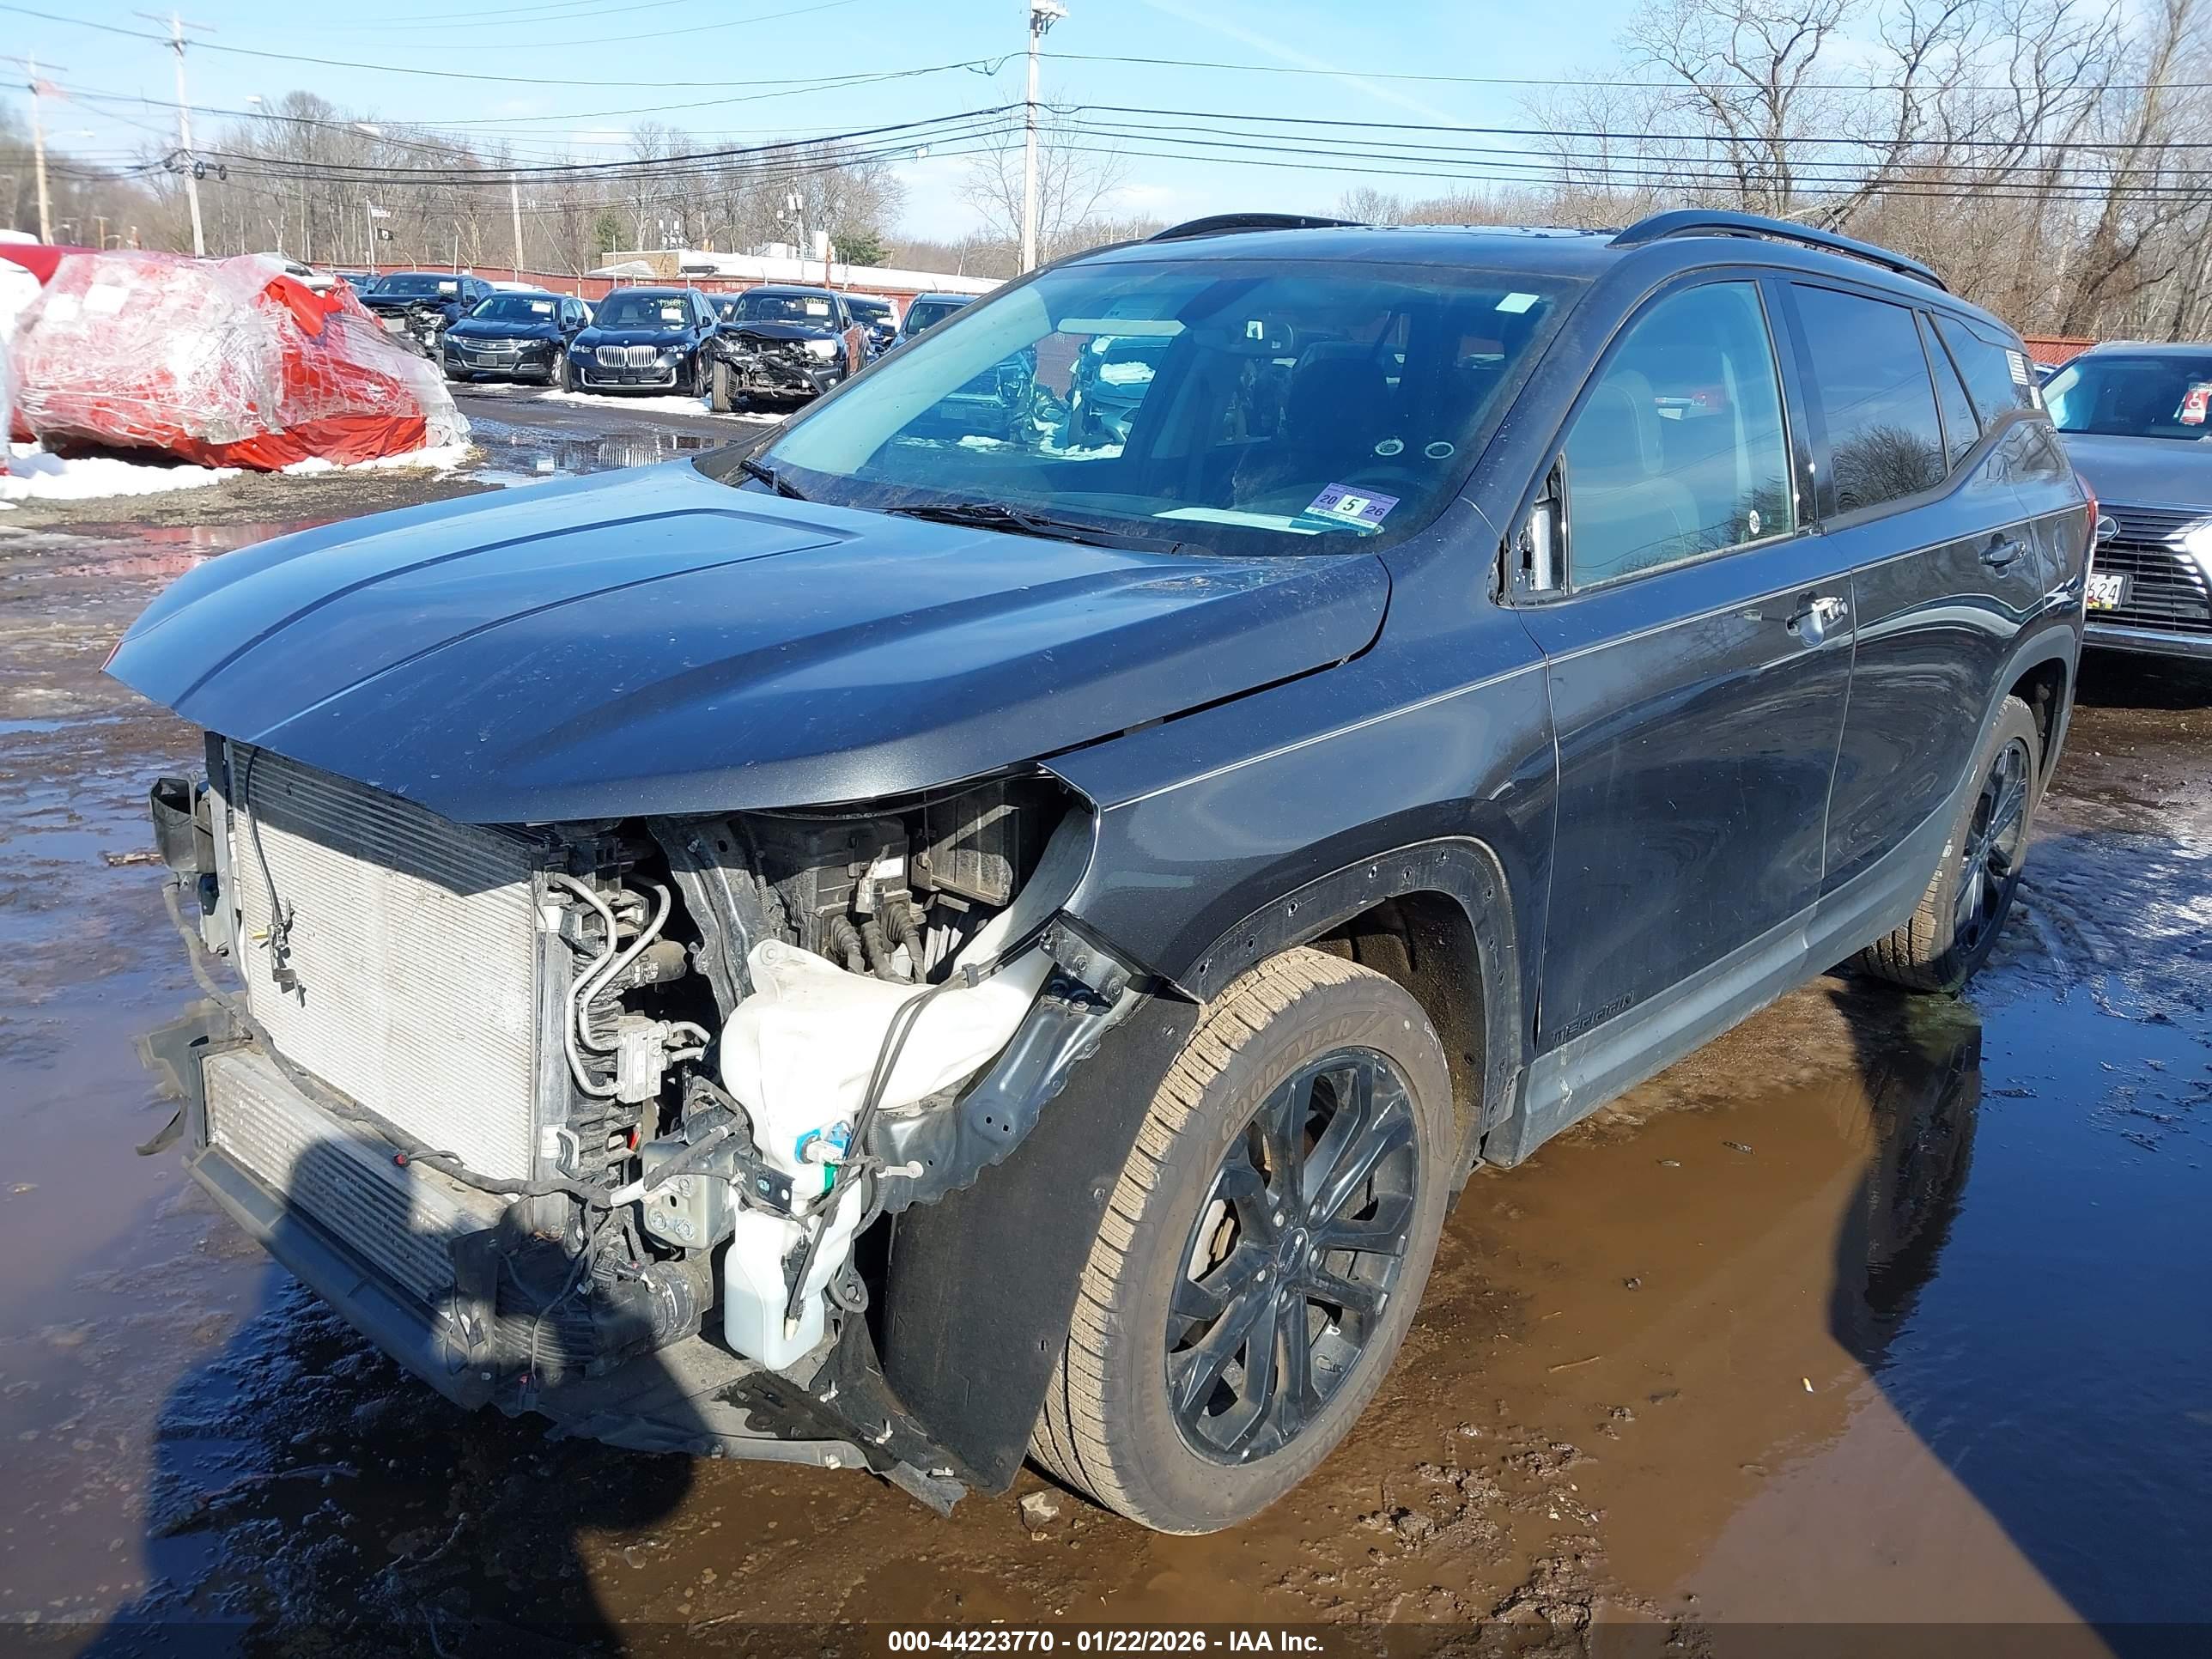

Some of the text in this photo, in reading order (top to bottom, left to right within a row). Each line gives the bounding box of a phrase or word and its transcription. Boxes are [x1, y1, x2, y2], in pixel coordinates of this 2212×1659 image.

[1318, 495, 1386, 517] 20 5 26
